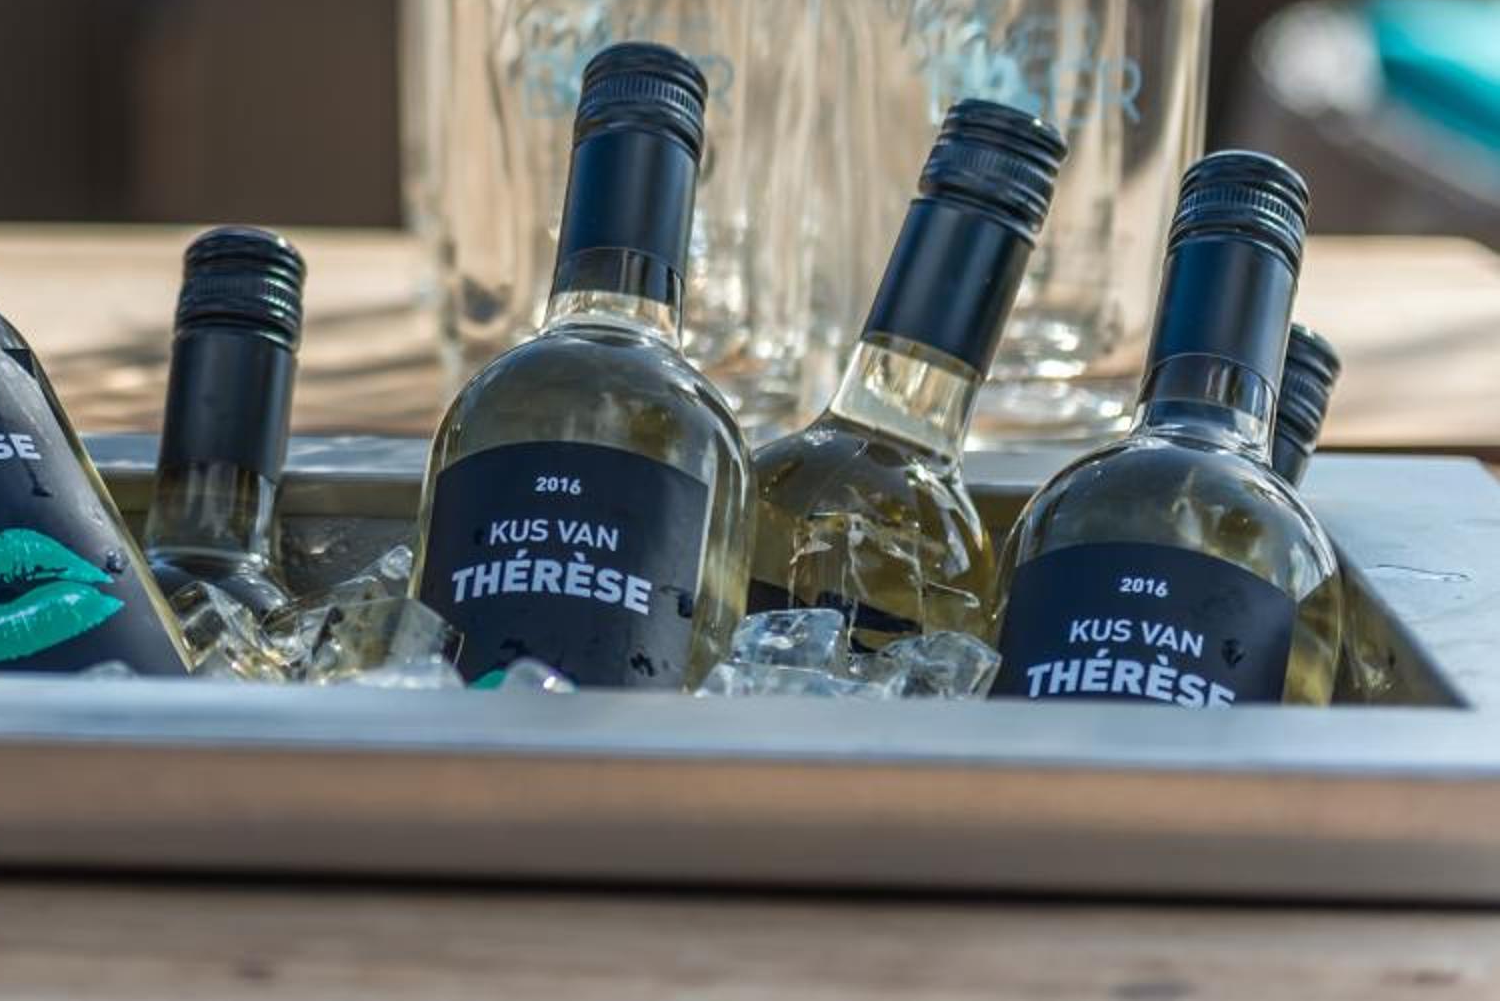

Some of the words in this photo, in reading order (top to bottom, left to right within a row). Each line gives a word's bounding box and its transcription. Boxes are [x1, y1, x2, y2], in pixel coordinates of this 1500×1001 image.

[535, 476, 582, 496] 2016
[489, 519, 549, 546] KUS
[557, 519, 619, 552] VAN
[451, 549, 653, 616] THÉRÈSE
[1119, 577, 1169, 598] 2016
[1069, 618, 1132, 644] KUS
[1141, 620, 1204, 658] VAN
